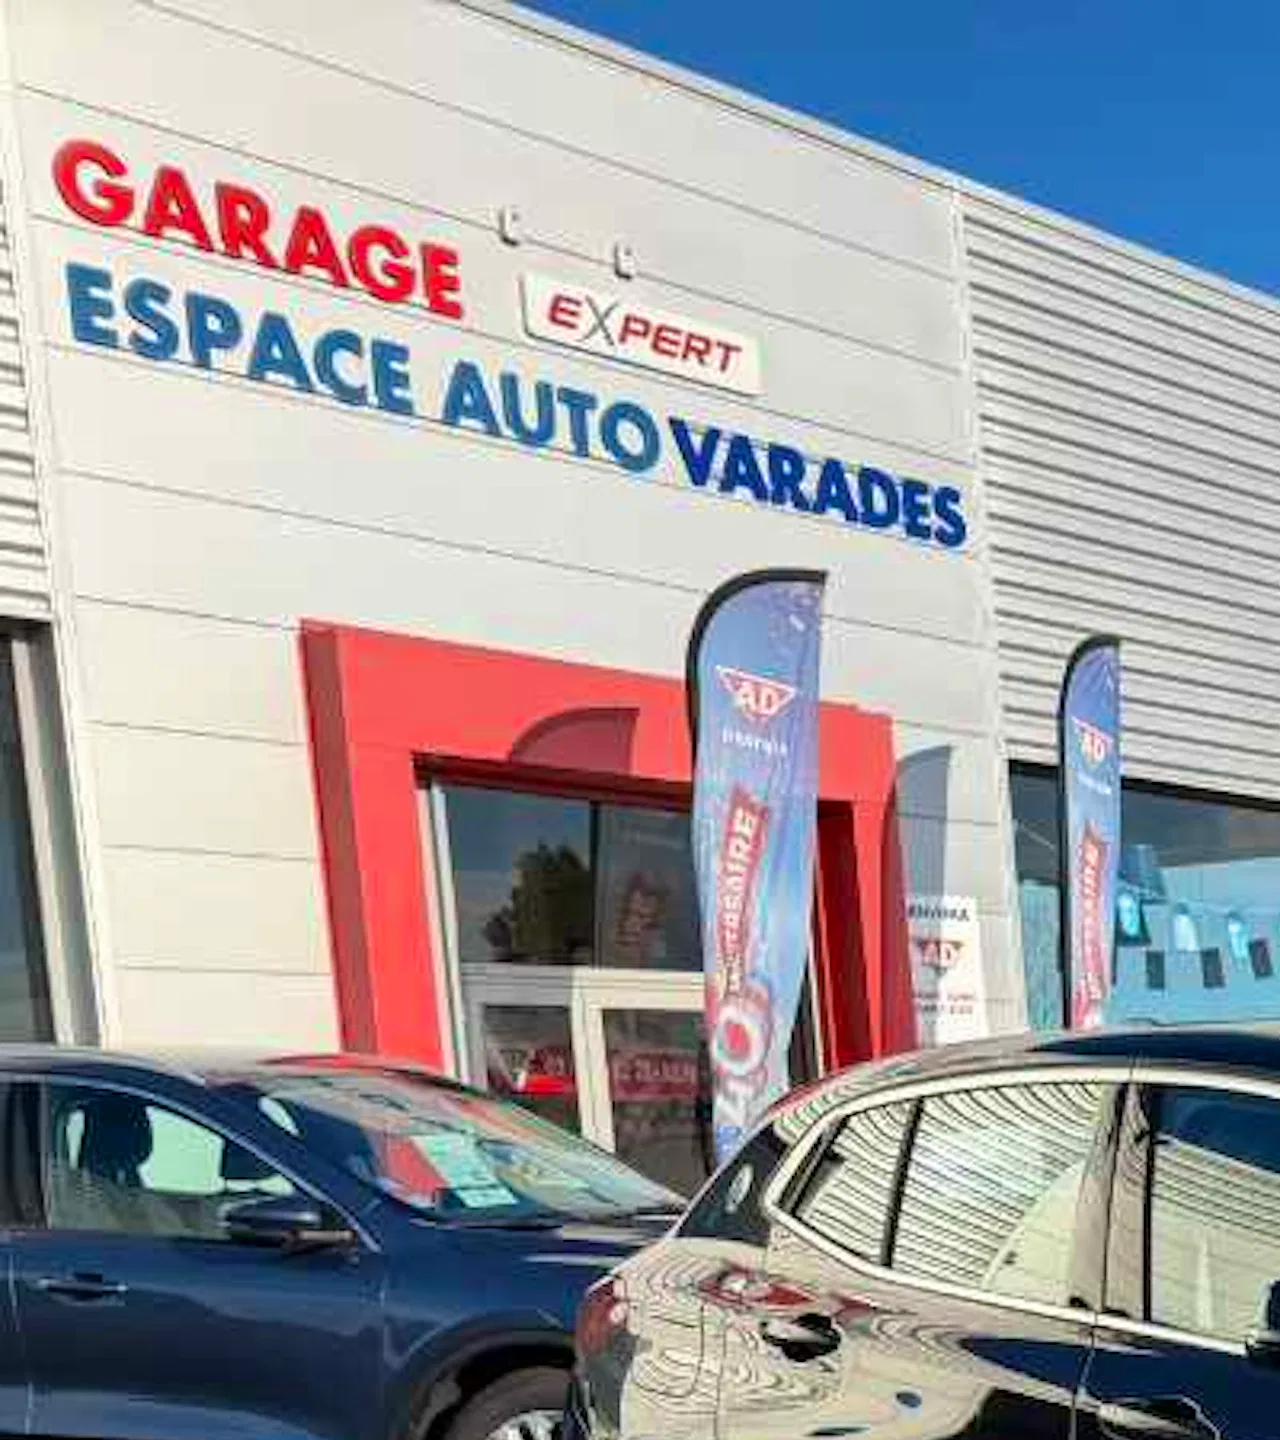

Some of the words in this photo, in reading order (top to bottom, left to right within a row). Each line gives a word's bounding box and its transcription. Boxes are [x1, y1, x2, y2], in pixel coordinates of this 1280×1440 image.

[53, 139, 465, 320] GARAGE
[64, 262, 413, 416] ESPACE
[440, 361, 661, 474] AUTO
[668, 416, 968, 549] VARADES
[547, 293, 742, 374] EXPERT
